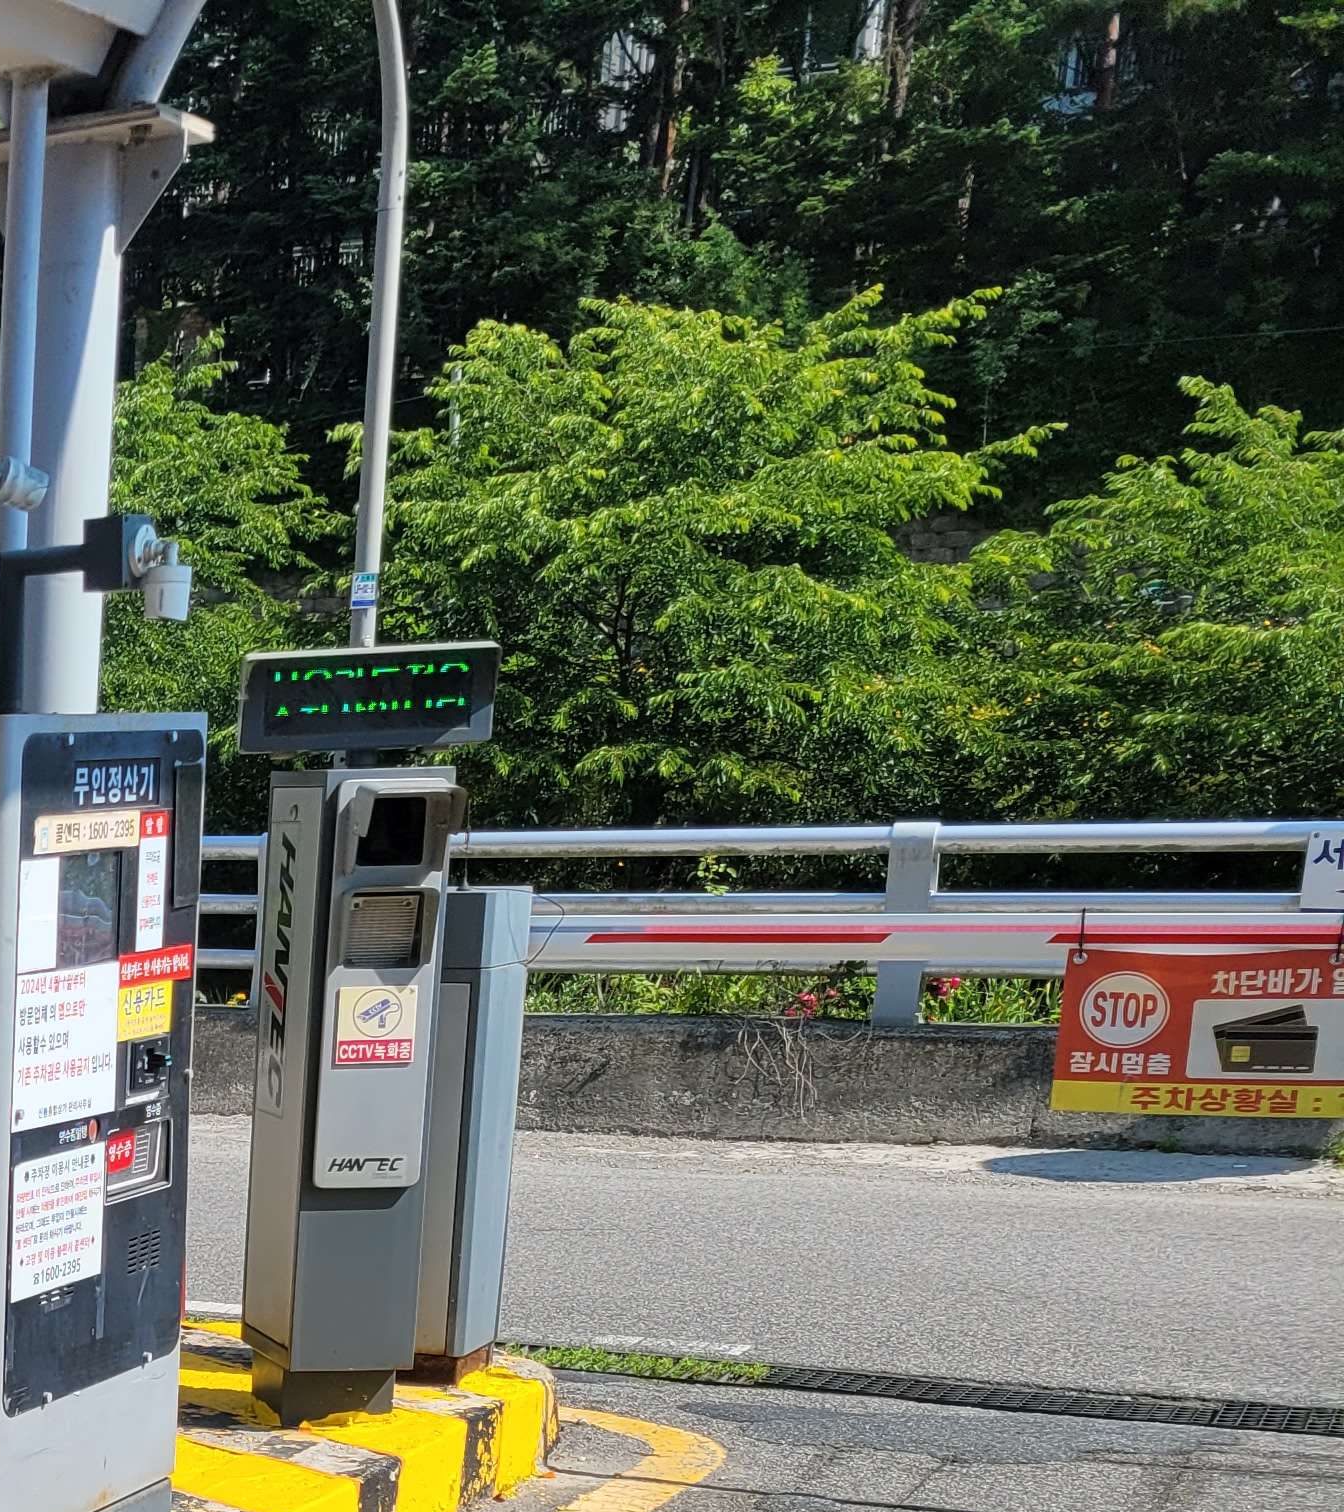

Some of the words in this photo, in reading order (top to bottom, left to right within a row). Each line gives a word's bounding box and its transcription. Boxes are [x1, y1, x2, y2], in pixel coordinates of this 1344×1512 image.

[74, 763, 154, 806] 무인정산기
[89, 819, 135, 840] 1600-2395
[21, 976, 47, 995] 2024년
[1211, 968, 1322, 996] 차단바가
[123, 987, 165, 1015] 신용카드
[1091, 991, 1158, 1029] STOP
[340, 1042, 411, 1059] CCTV녹화중
[1069, 1051, 1171, 1075] 잠시멈춤
[1130, 1087, 1298, 1114] 주차상황실
[109, 1140, 132, 1162] 영수증
[41, 1258, 81, 1283] 1600-2395
